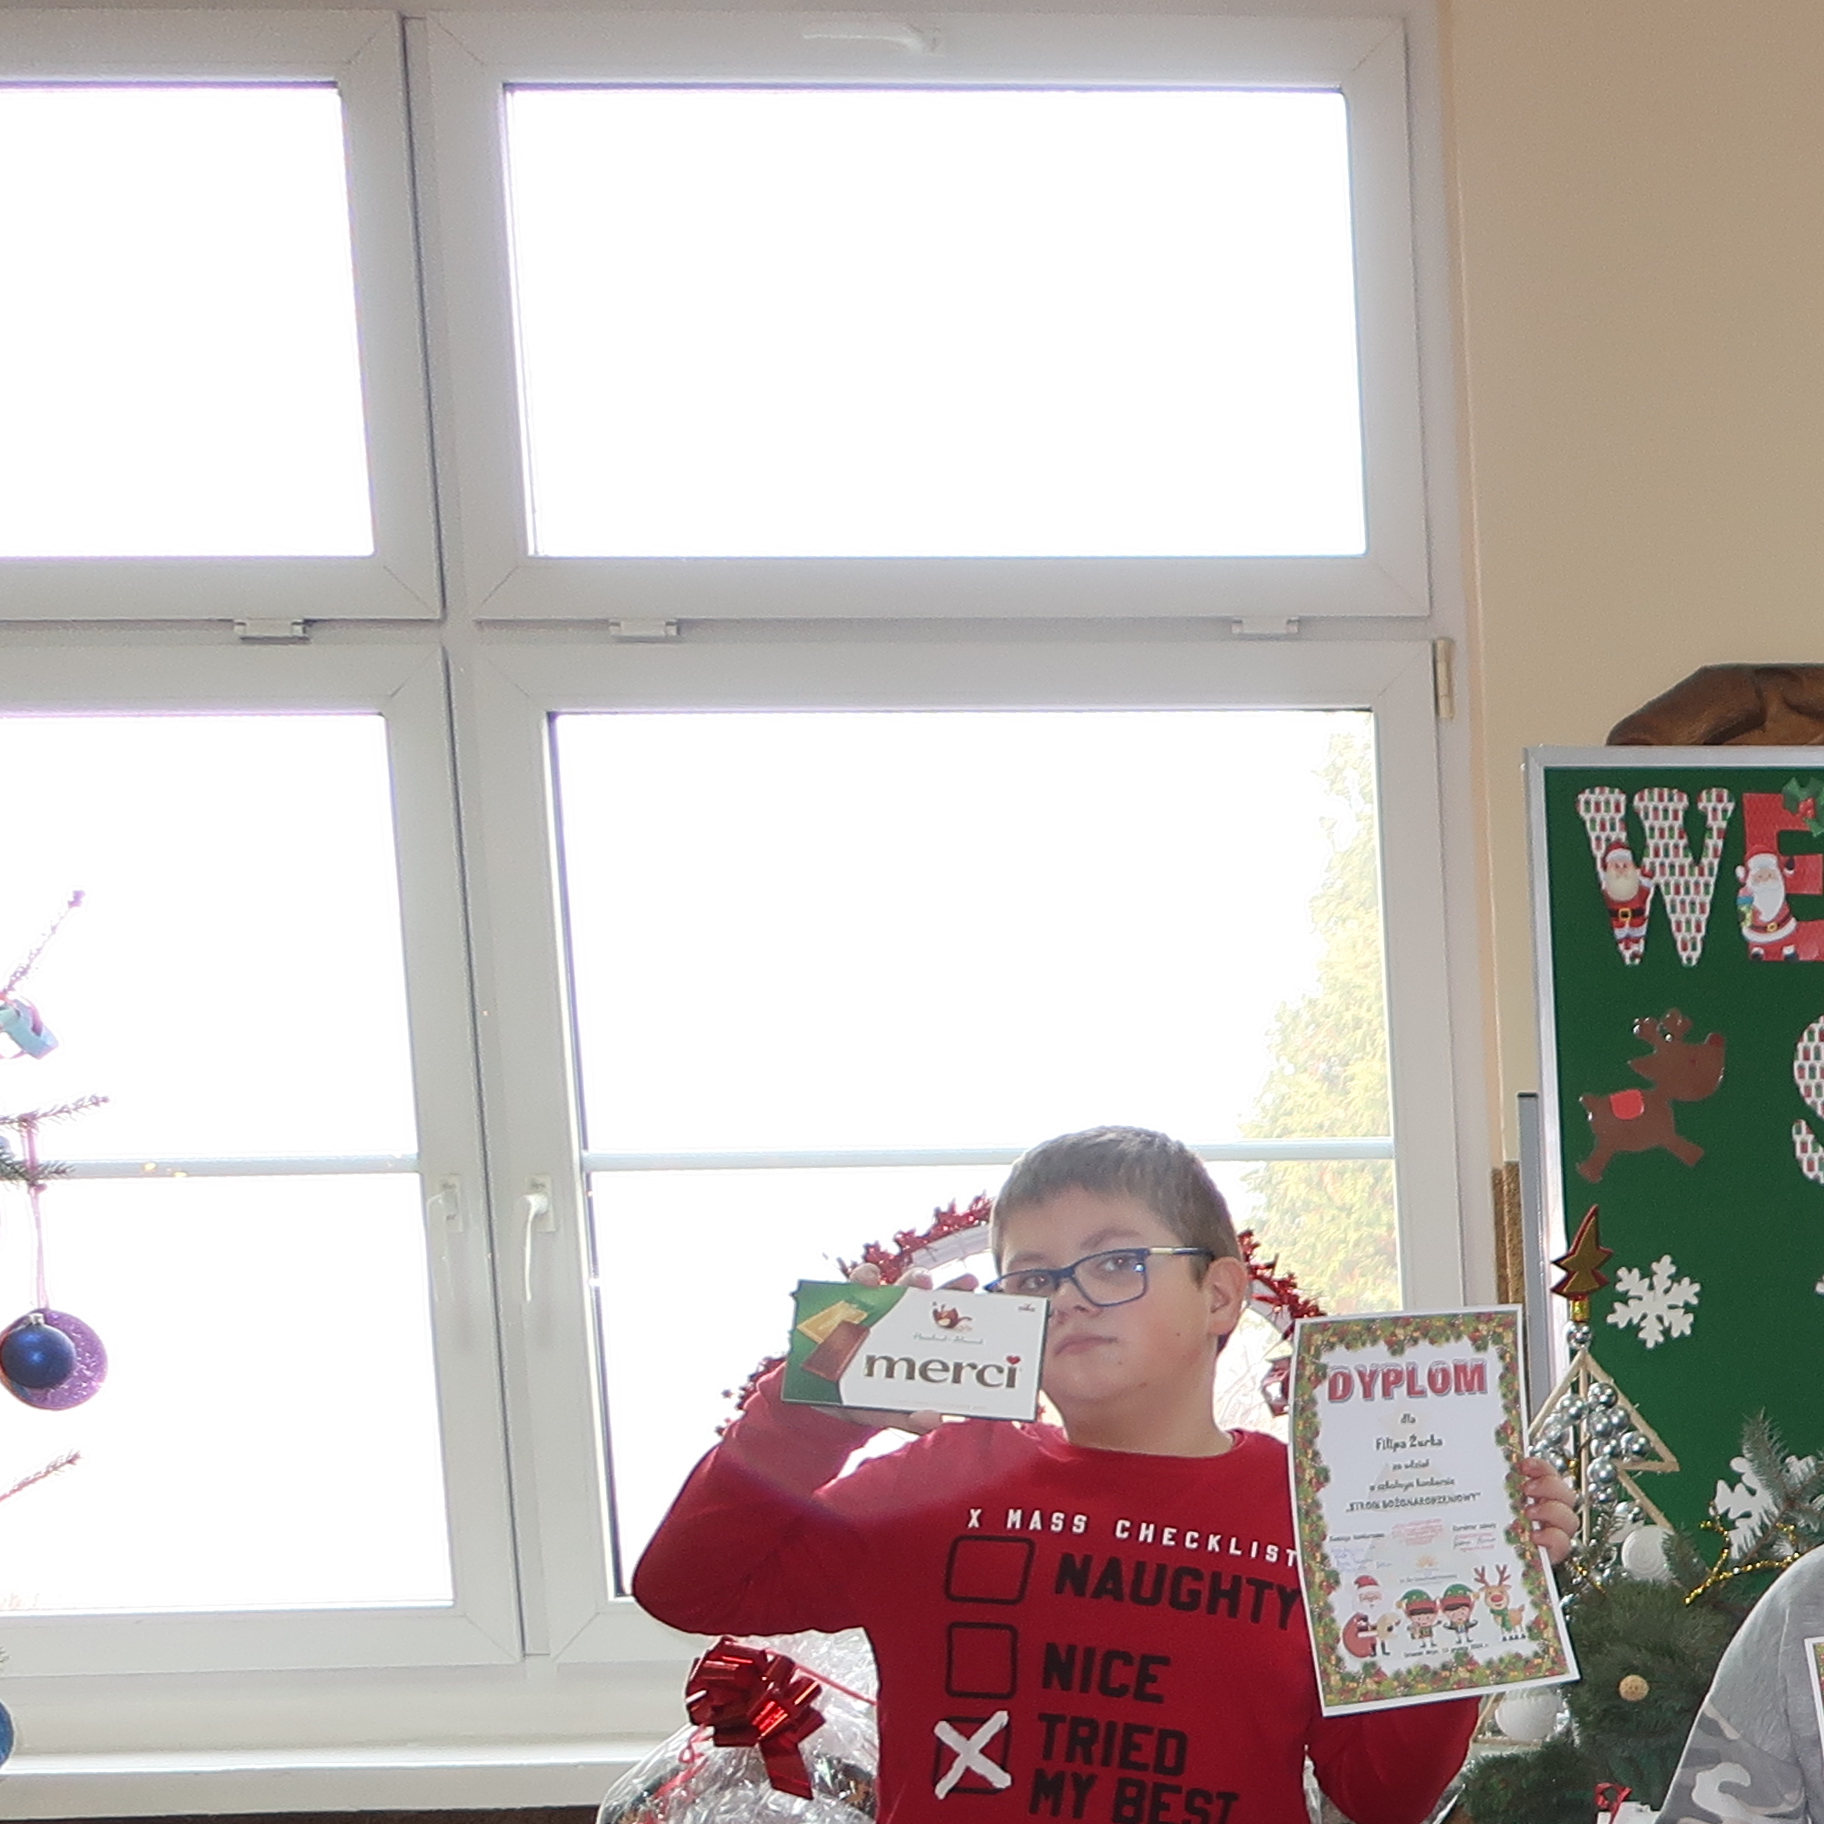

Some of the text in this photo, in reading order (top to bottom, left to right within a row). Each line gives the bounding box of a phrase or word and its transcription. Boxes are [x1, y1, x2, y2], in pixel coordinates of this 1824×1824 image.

[864, 1354, 1021, 1389] merci
[1327, 1358, 1488, 1403] DYPLOM
[967, 1509, 982, 1528] X
[1006, 1509, 1088, 1534] MASS
[1115, 1519, 1300, 1567] CHECKLIST
[1054, 1553, 1302, 1631] NAUGHTY
[1041, 1642, 1171, 1704] NICE
[1037, 1712, 1188, 1777] TRIED
[1028, 1769, 1097, 1819] MY
